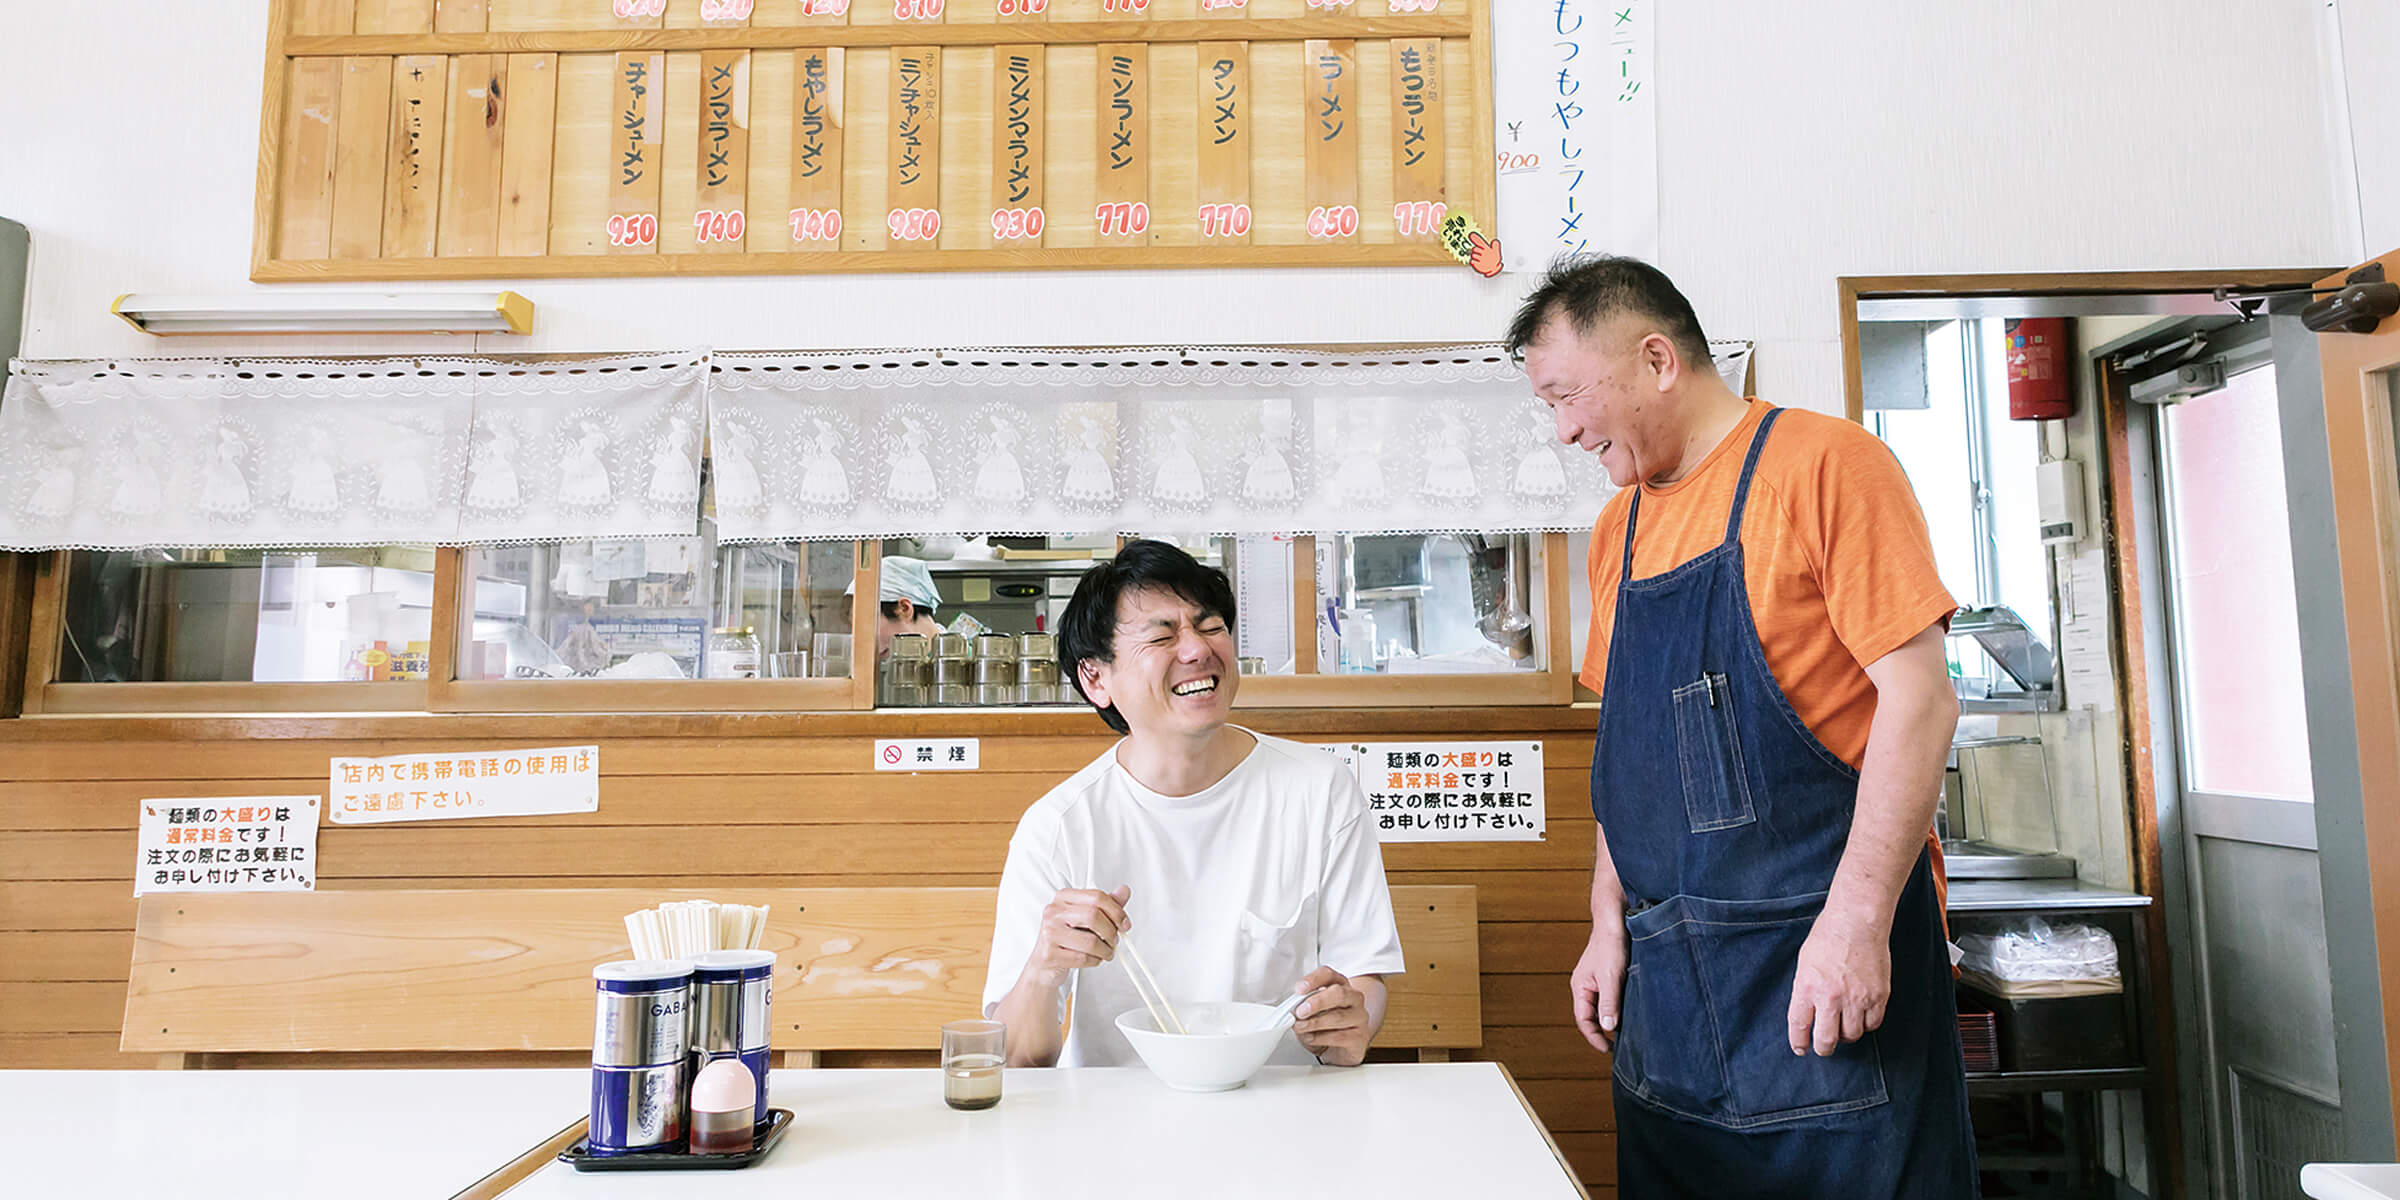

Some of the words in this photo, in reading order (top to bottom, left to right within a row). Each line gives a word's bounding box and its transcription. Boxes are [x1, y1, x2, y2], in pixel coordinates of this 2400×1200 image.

[1111, 56, 1133, 170] ミンラーメン
[1213, 59, 1236, 144] タンメン
[1319, 56, 1343, 141] ラーメン
[1400, 46, 1425, 166] もつラーメン
[622, 62, 646, 185] チャーシューメン
[707, 63, 731, 186] メンマラーメン
[801, 55, 826, 177] もやしラーメン
[900, 58, 920, 185] ミンチャーシューメン
[1008, 56, 1029, 202] ミンメンマラーメン
[1552, 0, 1587, 256] もつもやしラーメン
[1498, 152, 1539, 170] 900
[608, 214, 656, 246] 950
[696, 210, 744, 243] 740
[790, 208, 841, 241] 740
[889, 209, 939, 240] 980
[992, 208, 1043, 239] 930
[1097, 203, 1149, 236] 770
[1200, 205, 1250, 238] 770
[1307, 206, 1358, 238] 650
[1394, 202, 1446, 234] 770
[343, 755, 591, 784] 店内で携帯電話の使用は
[917, 746, 965, 762] 禁煙
[1387, 752, 1512, 768] 麺類の大盛りは
[168, 806, 290, 824] 麺類の大盛りは
[343, 791, 485, 812] ご遠慮下さい。
[1370, 792, 1532, 810] 注文の際にお気軽に
[1379, 813, 1535, 830] お申し付け下さい。
[147, 847, 305, 865] 注文の際にお気軽に
[154, 868, 305, 885] お申し付け下さい。
